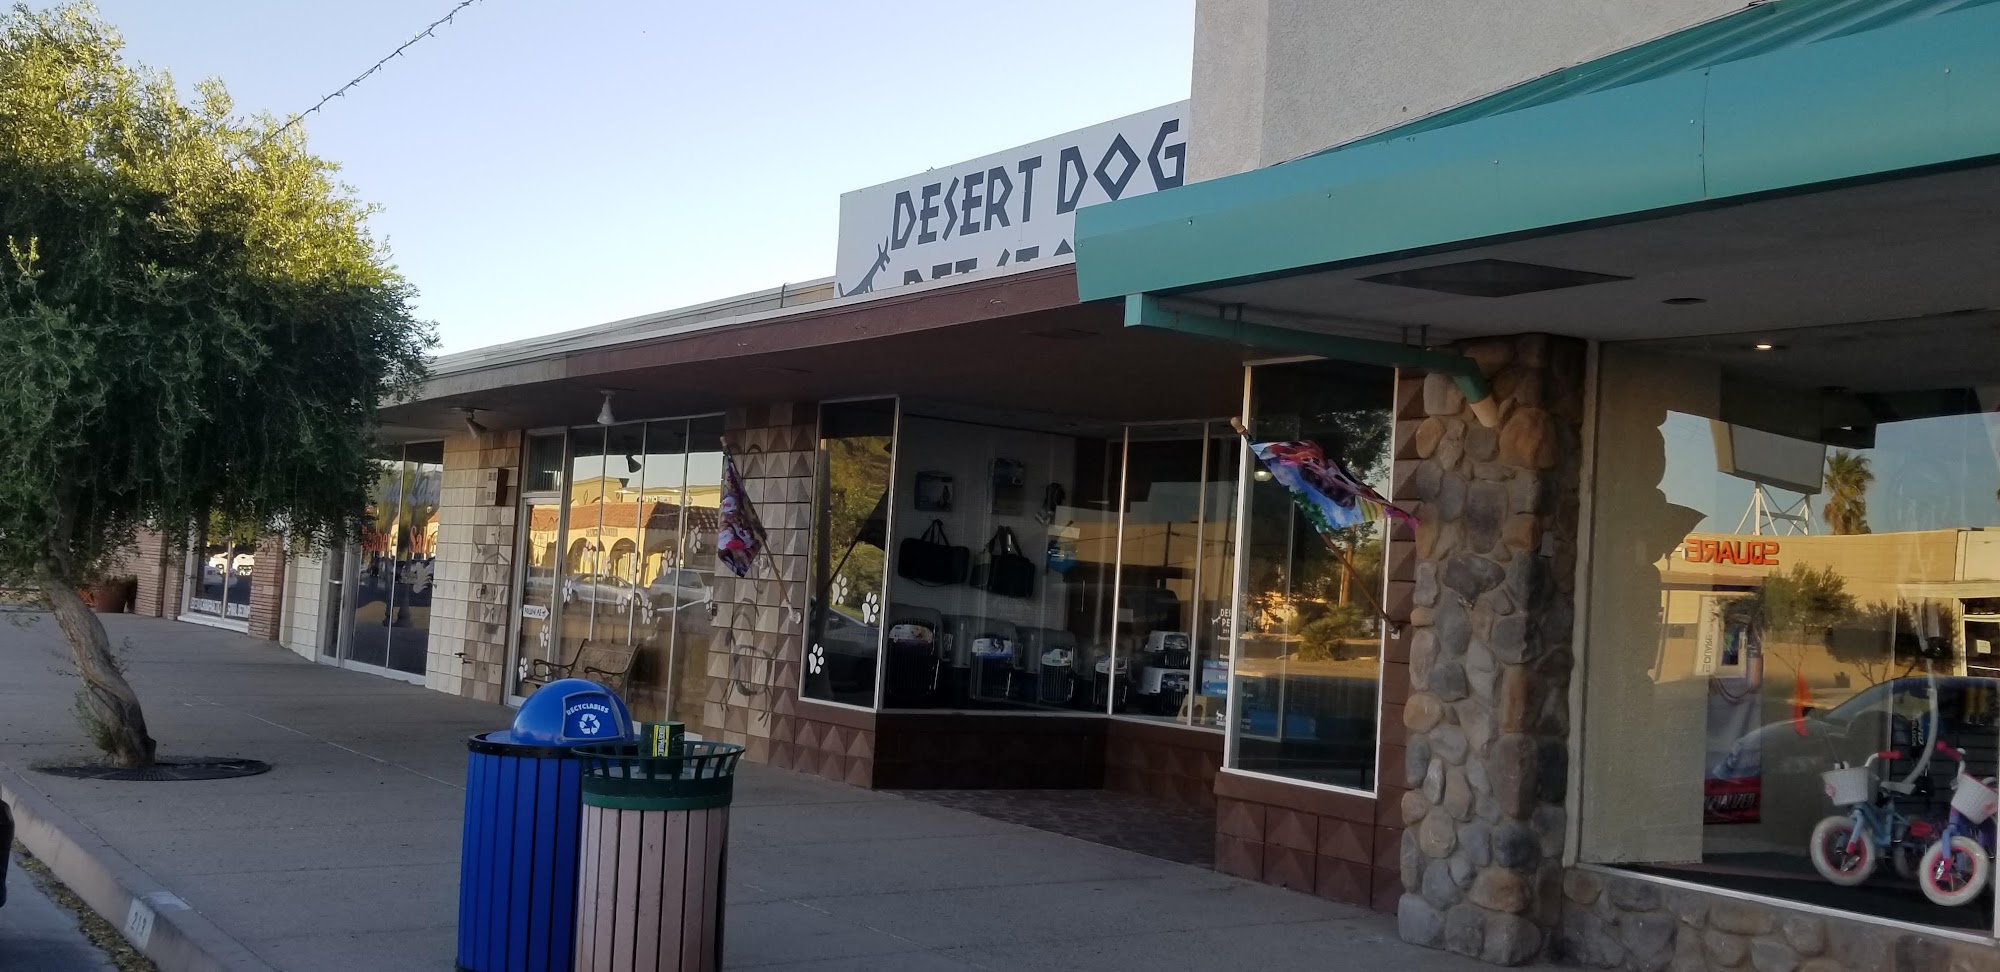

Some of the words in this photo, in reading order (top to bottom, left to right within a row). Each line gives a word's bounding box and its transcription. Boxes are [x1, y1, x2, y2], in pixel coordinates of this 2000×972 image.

[891, 155, 1042, 251] DESERT
[1056, 118, 1187, 216] DOG
[565, 702, 610, 717] RECYCLABLES
